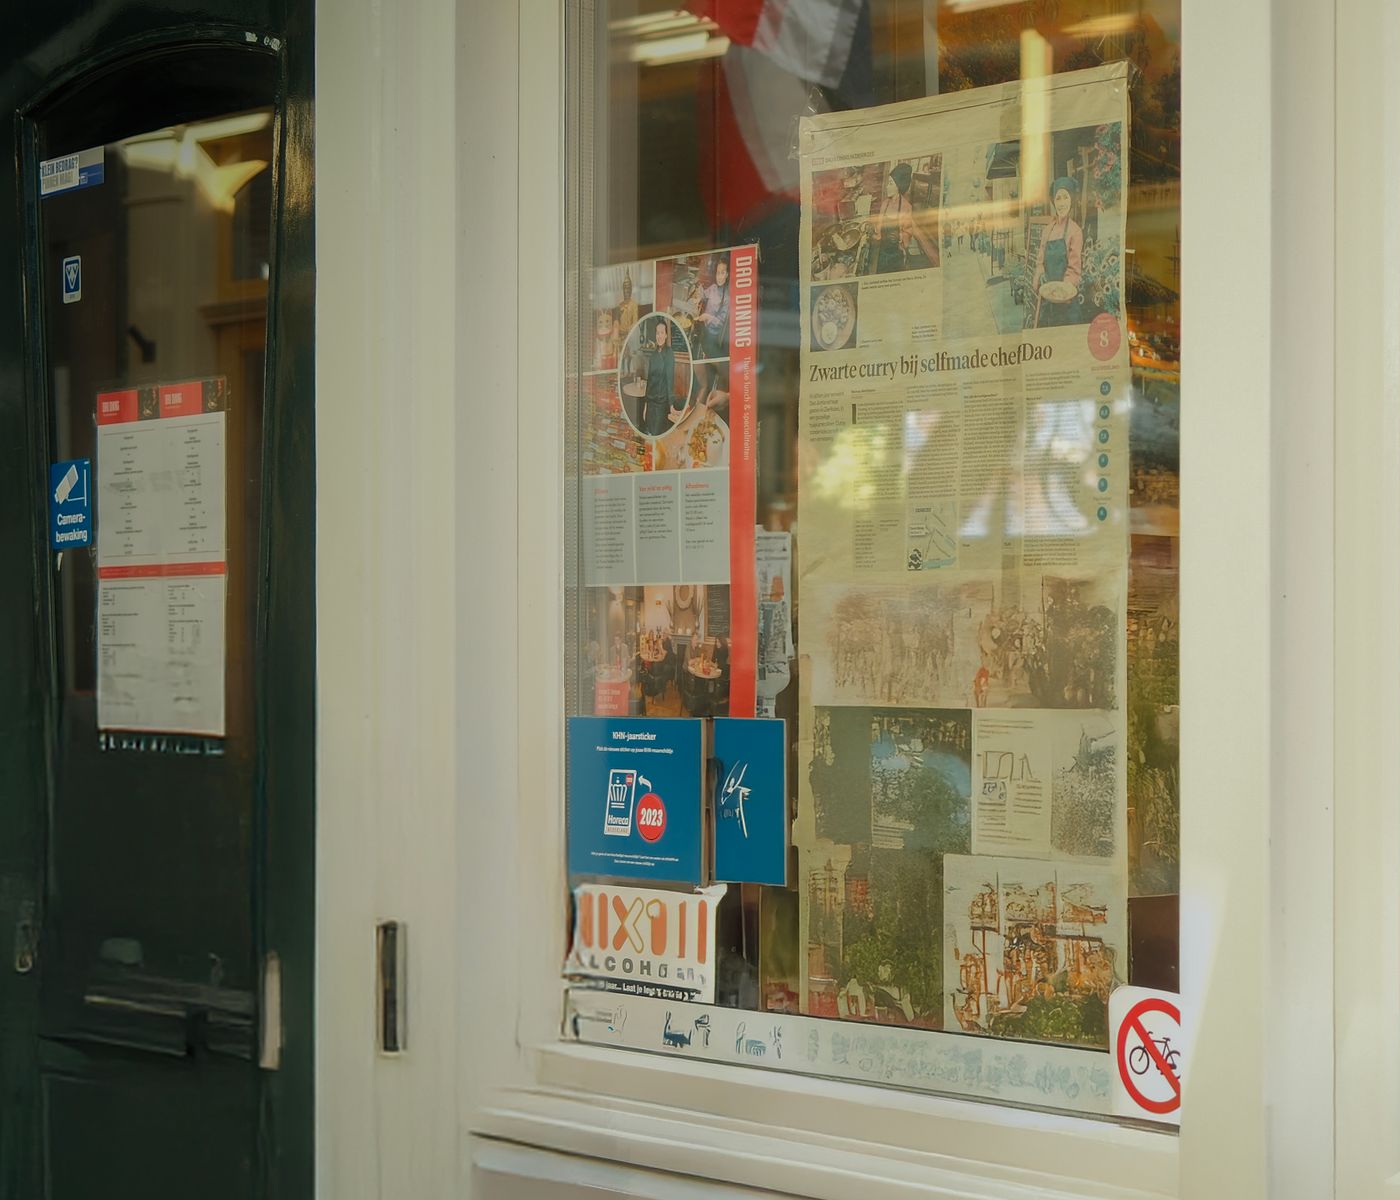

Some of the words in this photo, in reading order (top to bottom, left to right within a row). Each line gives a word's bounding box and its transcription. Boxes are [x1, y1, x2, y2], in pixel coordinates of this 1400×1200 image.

[735, 255, 752, 288] DAO
[735, 293, 752, 348] DINING
[1099, 330, 1109, 348] 8
[810, 364, 857, 382] Zwarte
[859, 360, 898, 380] curry
[900, 354, 918, 378] bij
[920, 349, 988, 372] selfmade
[57, 513, 86, 526] Camera-
[56, 528, 88, 543] bewaking
[613, 731, 656, 741] KHN-jaarsticker
[607, 814, 629, 825] Horeca
[640, 807, 664, 827] 2023
[622, 982, 636, 992] Laat
